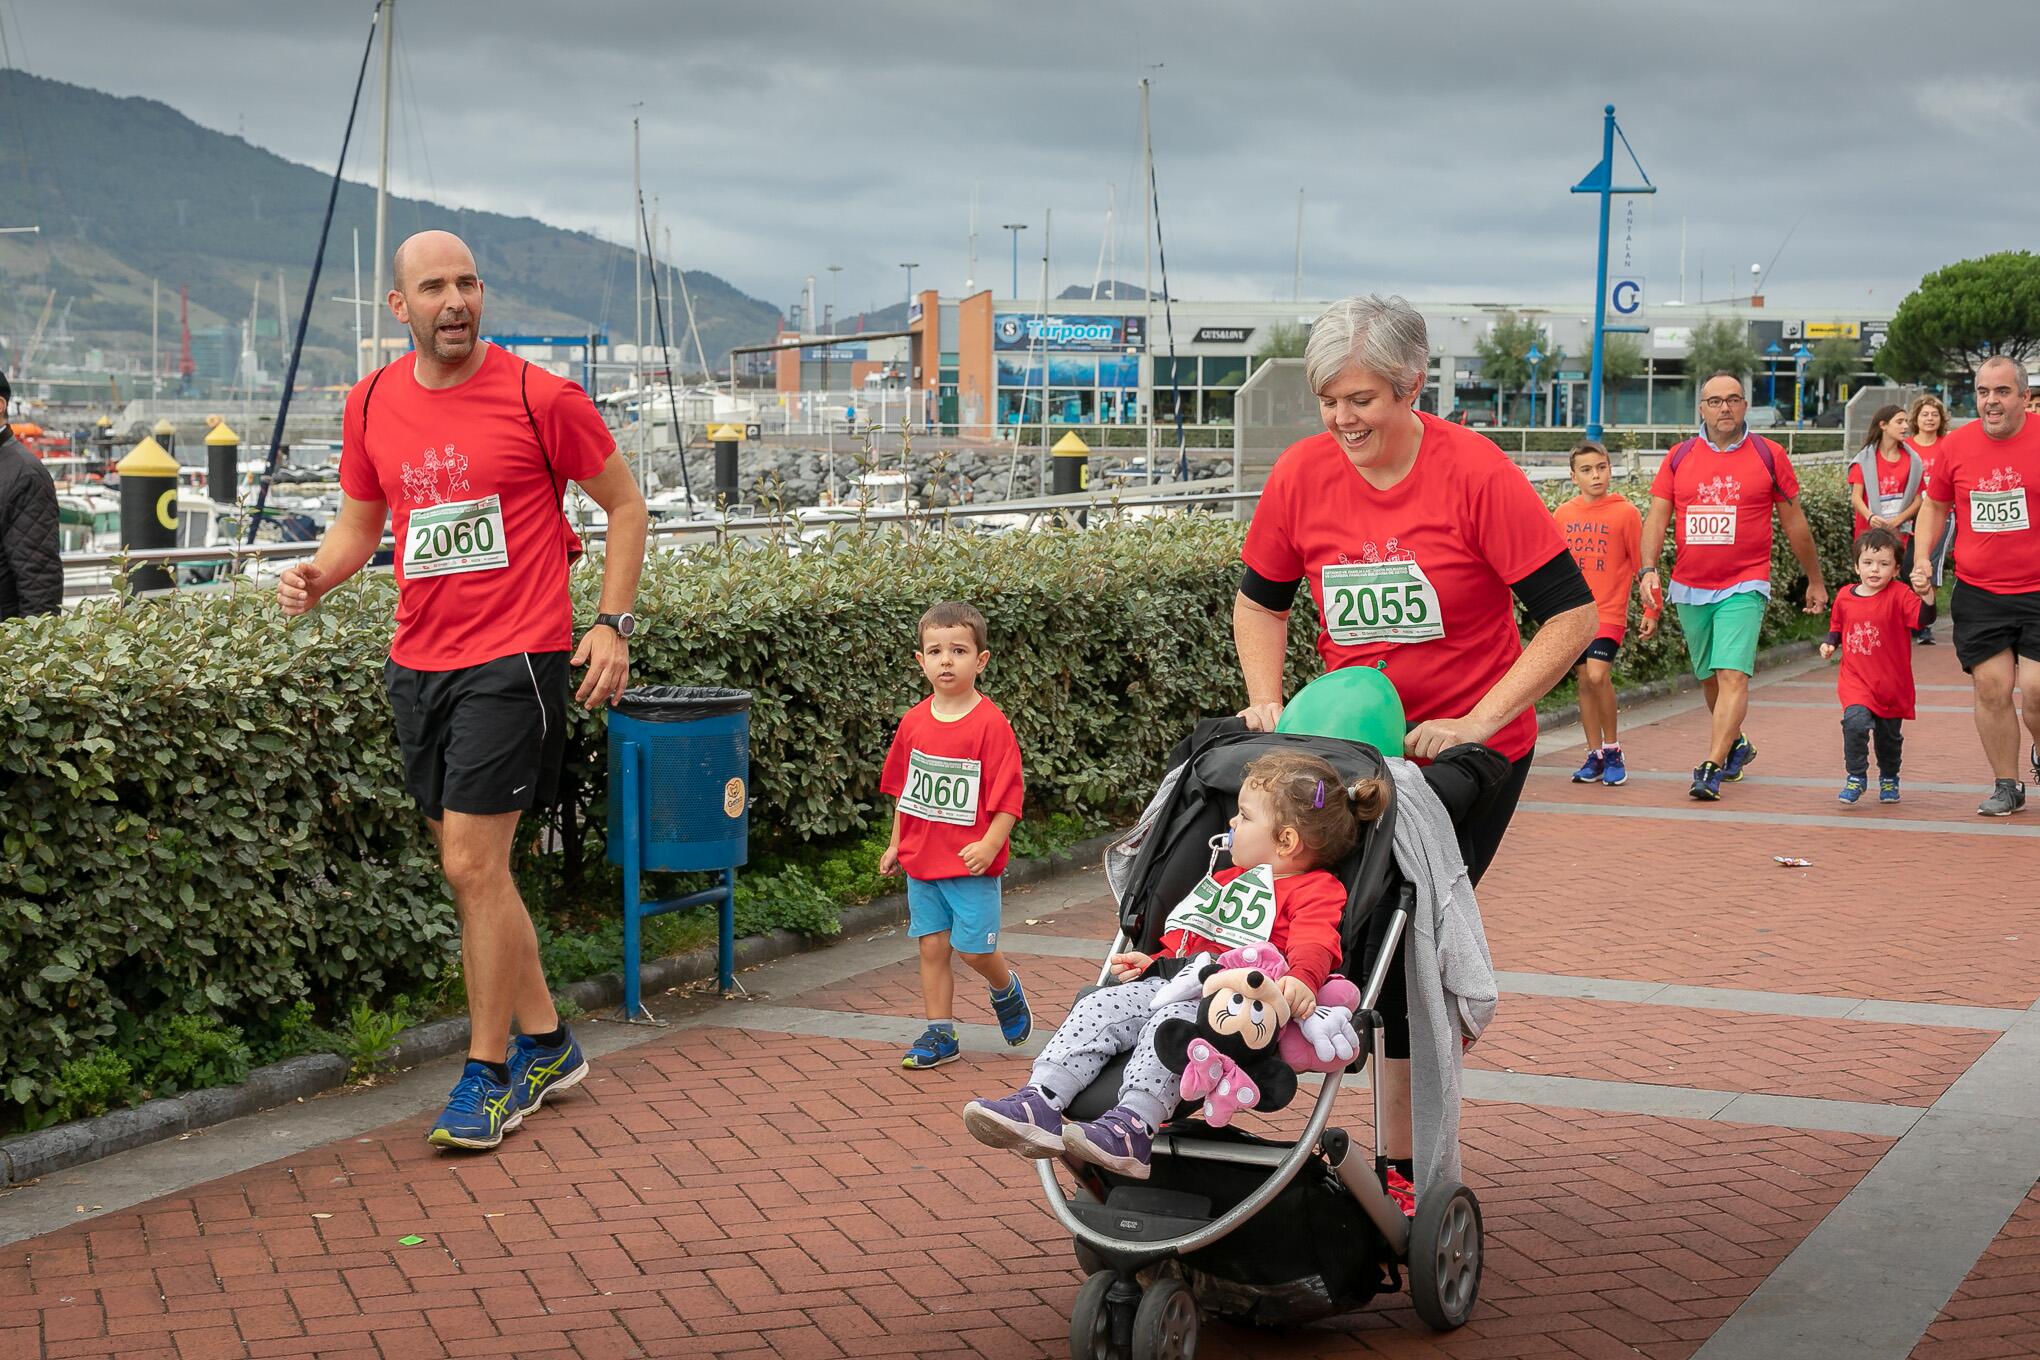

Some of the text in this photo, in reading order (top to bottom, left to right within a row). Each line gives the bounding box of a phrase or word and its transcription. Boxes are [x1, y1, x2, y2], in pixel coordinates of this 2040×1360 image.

[1624, 200, 1634, 268] PANTALAN
[1612, 280, 1641, 314] C
[1690, 516, 1730, 534] 3002
[1977, 501, 2021, 522] 2055
[414, 517, 494, 560] 2060
[1335, 584, 1427, 626] 2055
[911, 768, 969, 808] 2060
